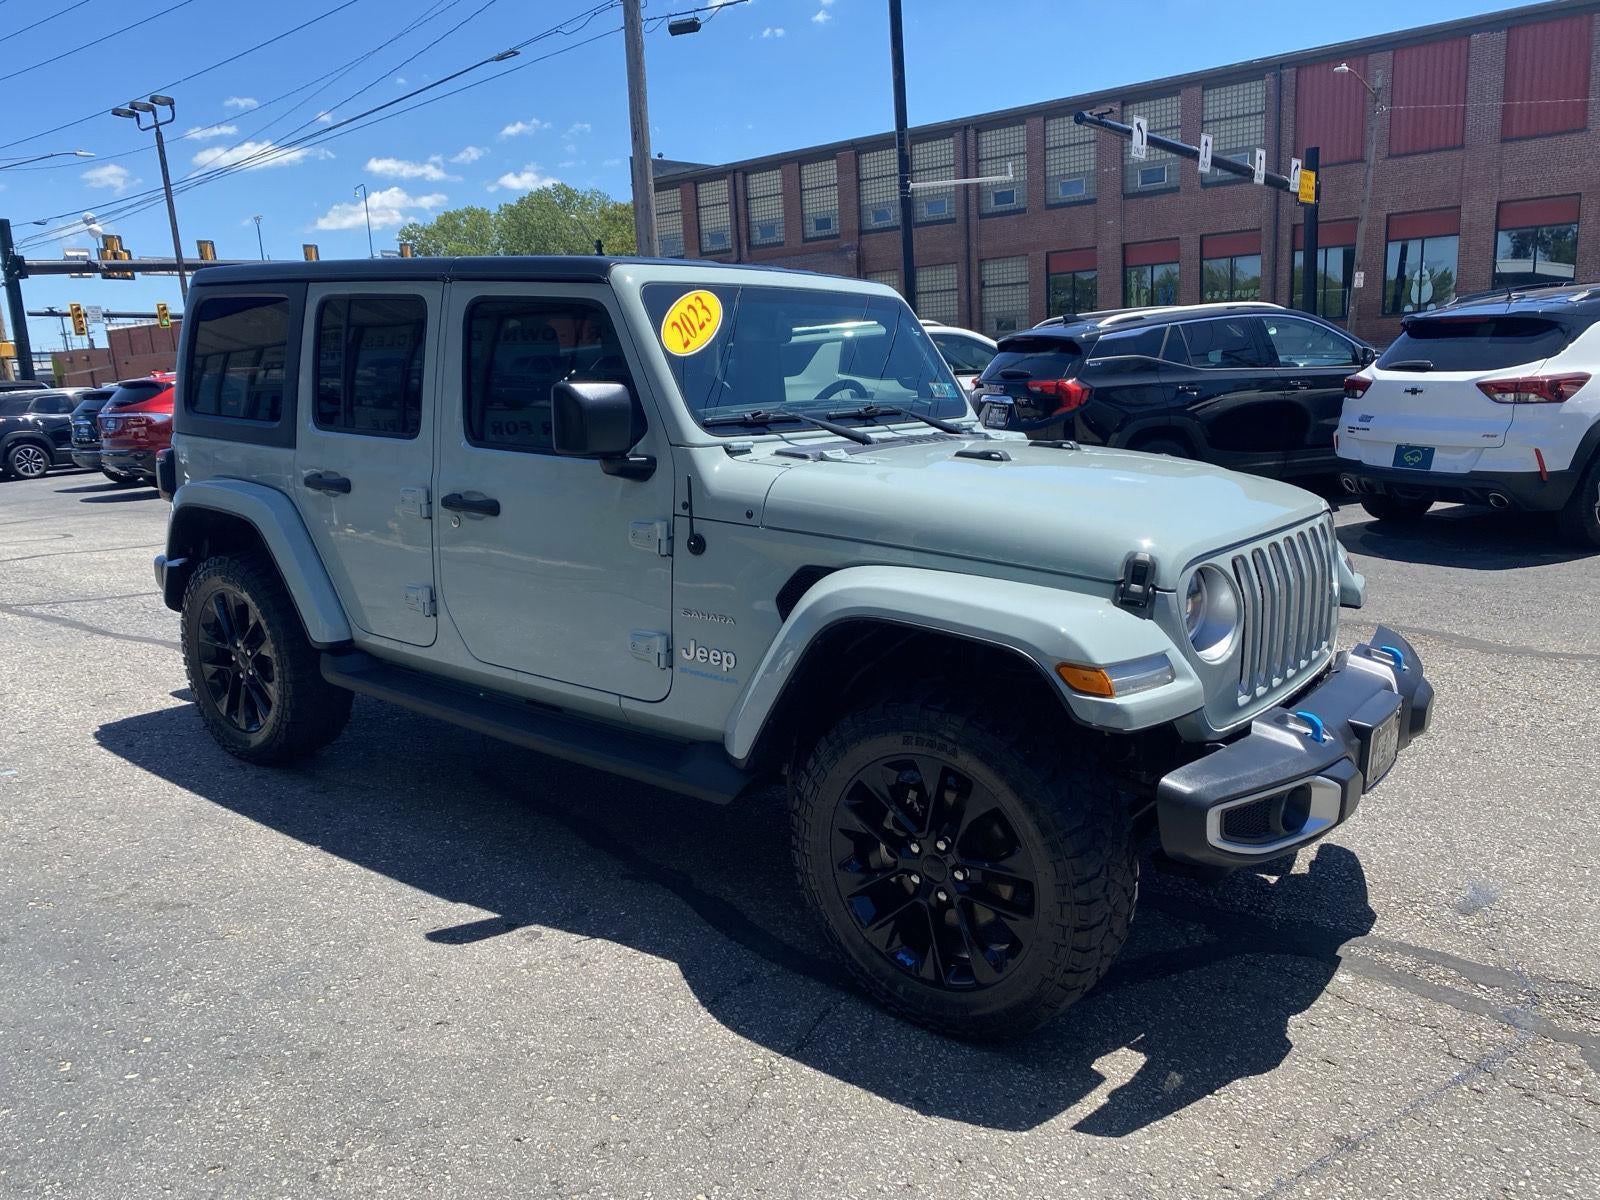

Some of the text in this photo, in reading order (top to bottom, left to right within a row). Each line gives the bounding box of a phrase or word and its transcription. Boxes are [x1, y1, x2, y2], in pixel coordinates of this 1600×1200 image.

[671, 296, 711, 349] 2023
[681, 608, 736, 625] SAHARA
[681, 638, 737, 672] Jeep
